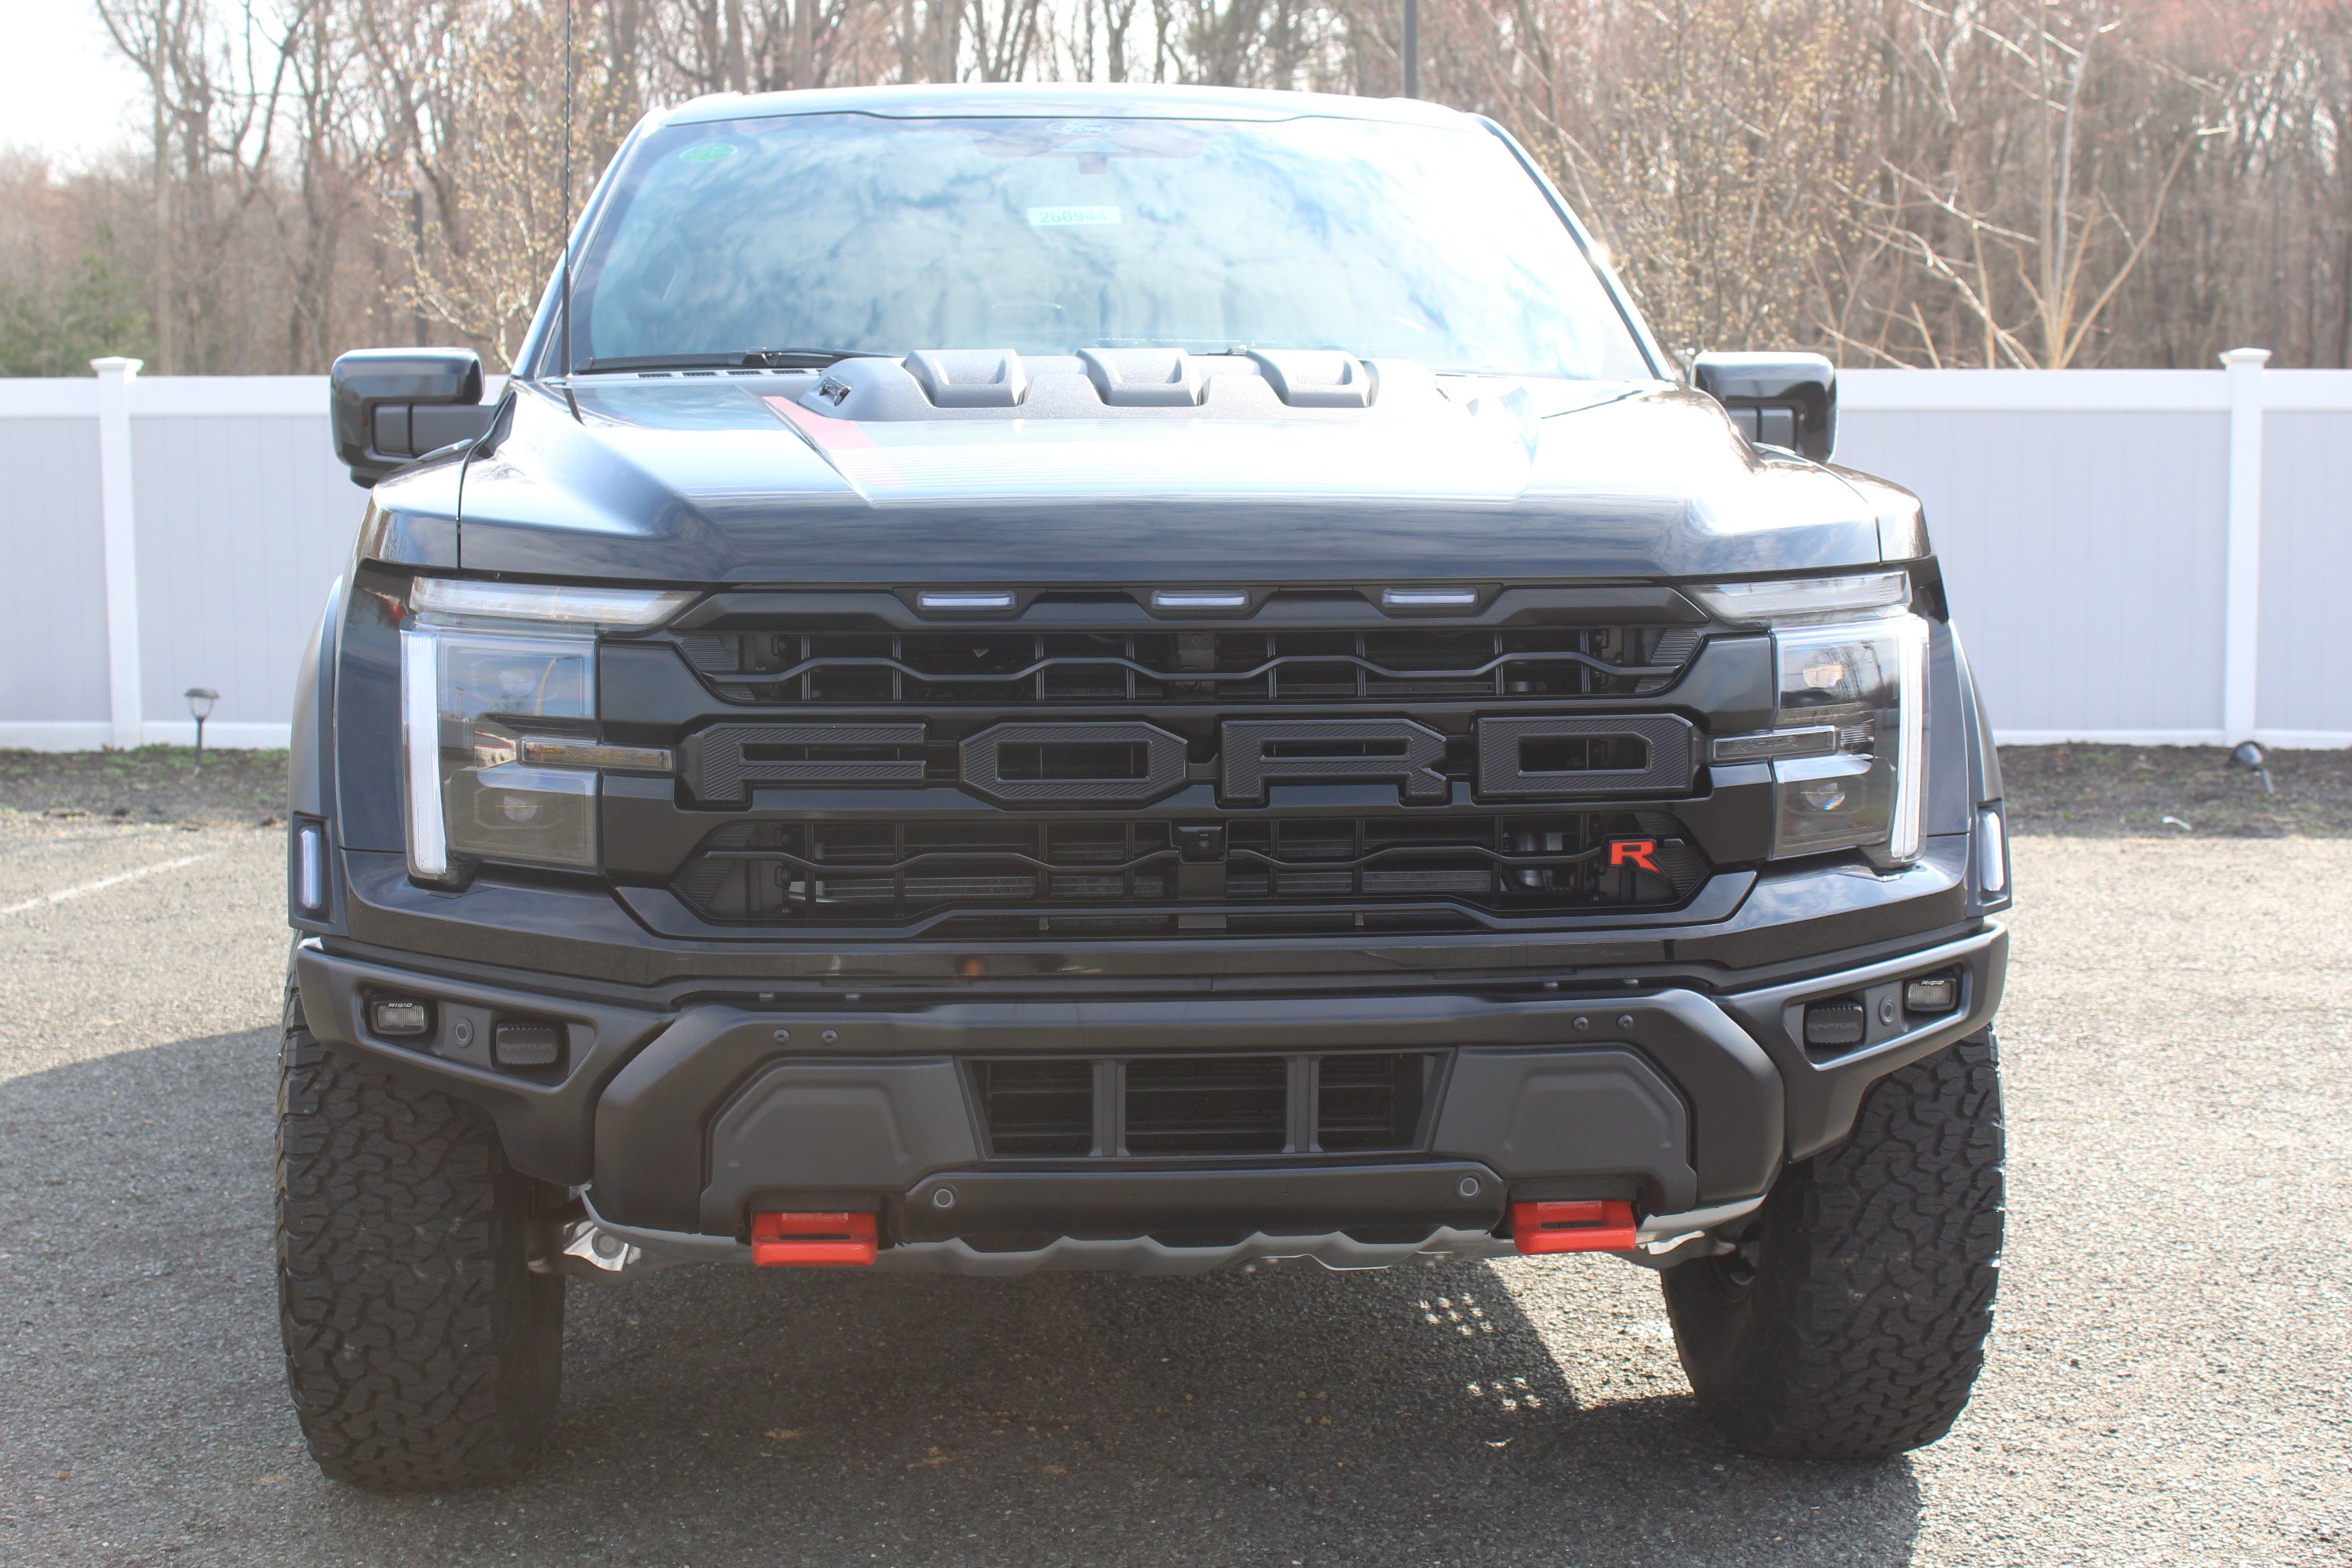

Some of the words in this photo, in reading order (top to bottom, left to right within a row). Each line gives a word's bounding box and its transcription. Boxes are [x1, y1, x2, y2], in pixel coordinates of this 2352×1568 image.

[1039, 210, 1108, 223] 260944
[700, 713, 1693, 800] FORD
[1610, 840, 1661, 872] R
[500, 1043, 555, 1051] RAPTOR
